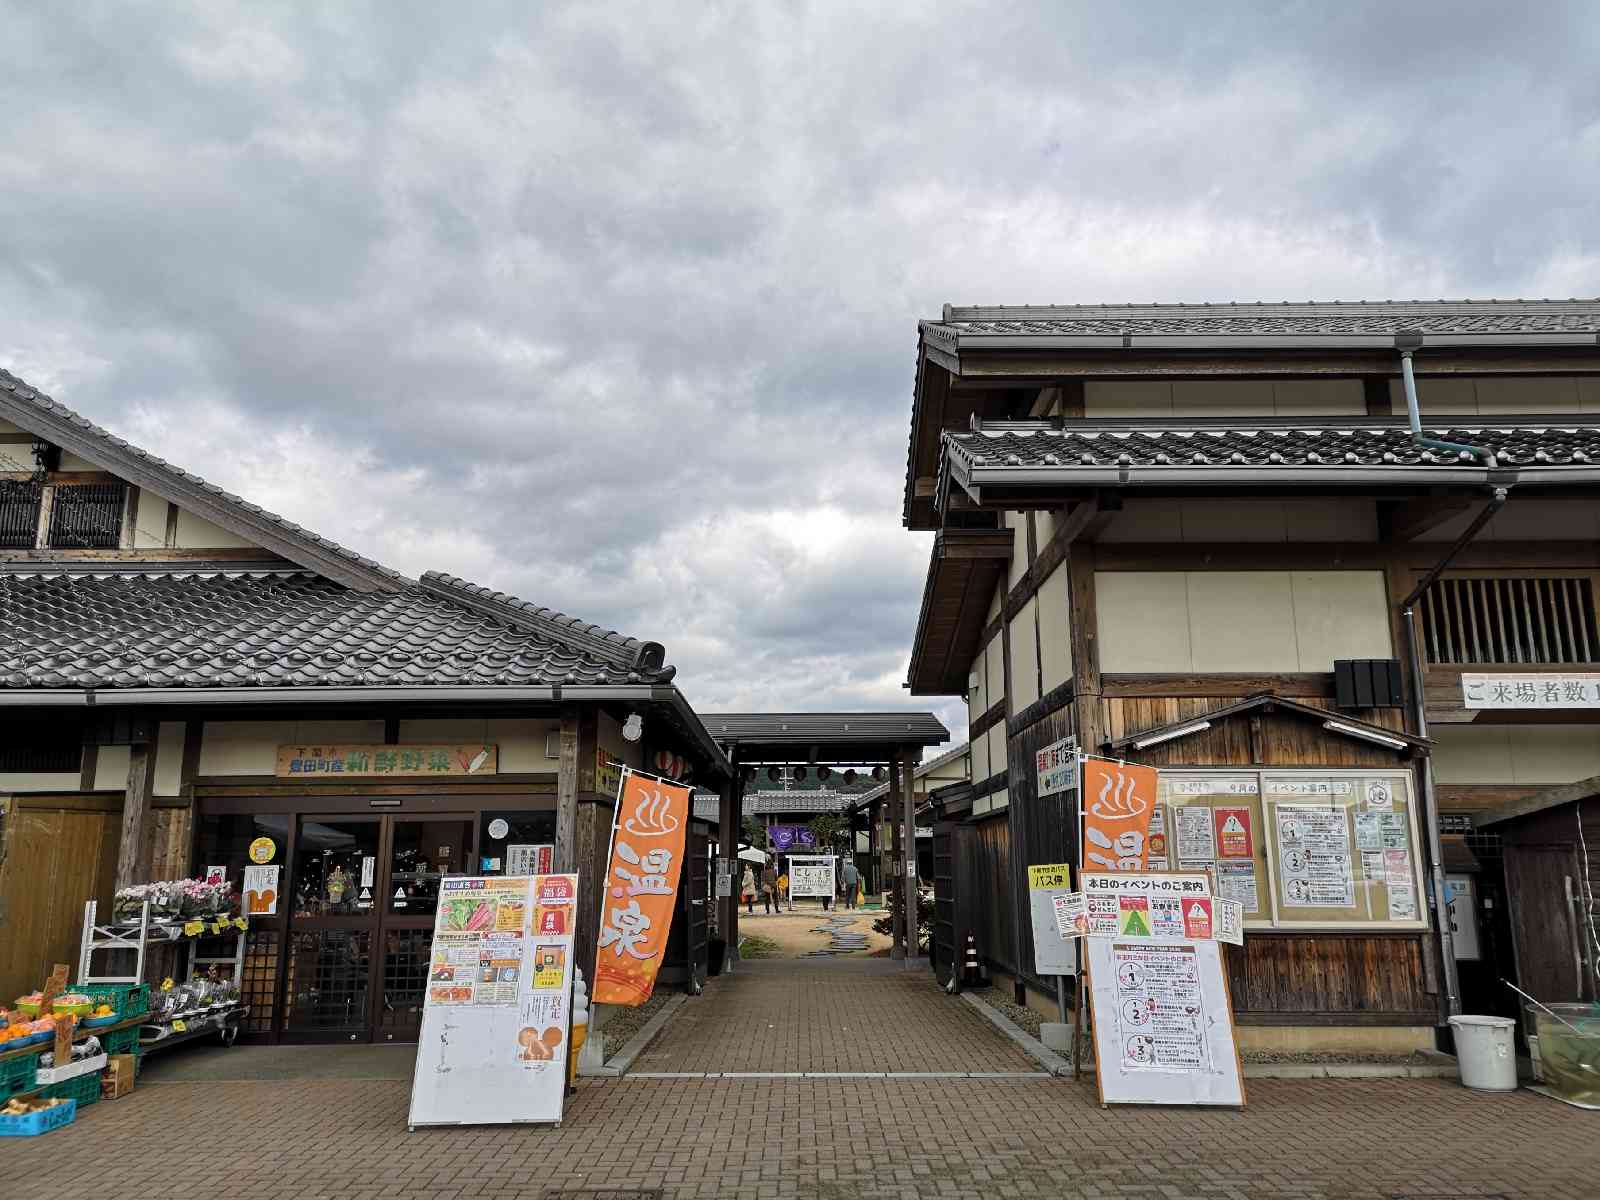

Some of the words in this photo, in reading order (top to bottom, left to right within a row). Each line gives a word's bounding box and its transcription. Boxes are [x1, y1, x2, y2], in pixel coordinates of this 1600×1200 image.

[598, 842, 674, 960] 温泉
[1088, 879, 1203, 892] 本日のイベントのご案内
